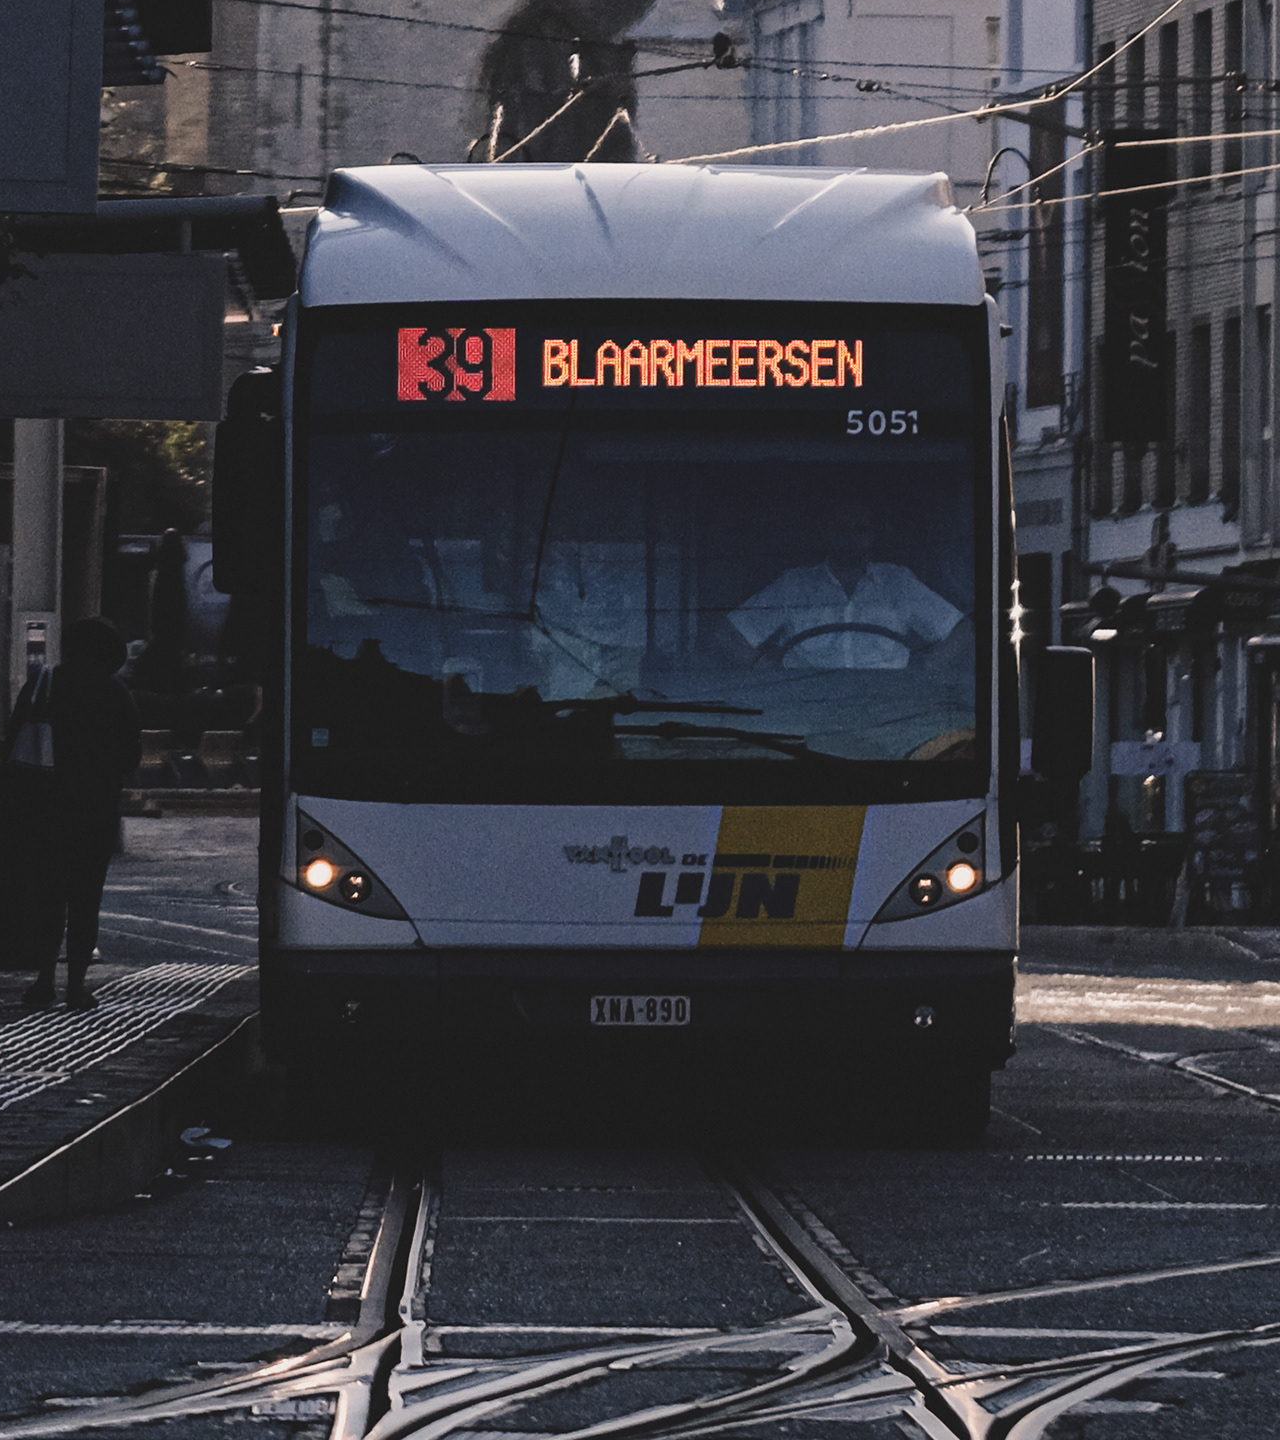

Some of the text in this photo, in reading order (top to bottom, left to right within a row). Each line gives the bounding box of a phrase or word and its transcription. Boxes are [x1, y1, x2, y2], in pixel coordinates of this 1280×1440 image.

[419, 328, 864, 401] 39 BLAARMEERSEN
[846, 409, 918, 436] 5051
[682, 853, 708, 866] DE
[634, 872, 801, 919] LIJN
[595, 997, 687, 1024] XNA-890
